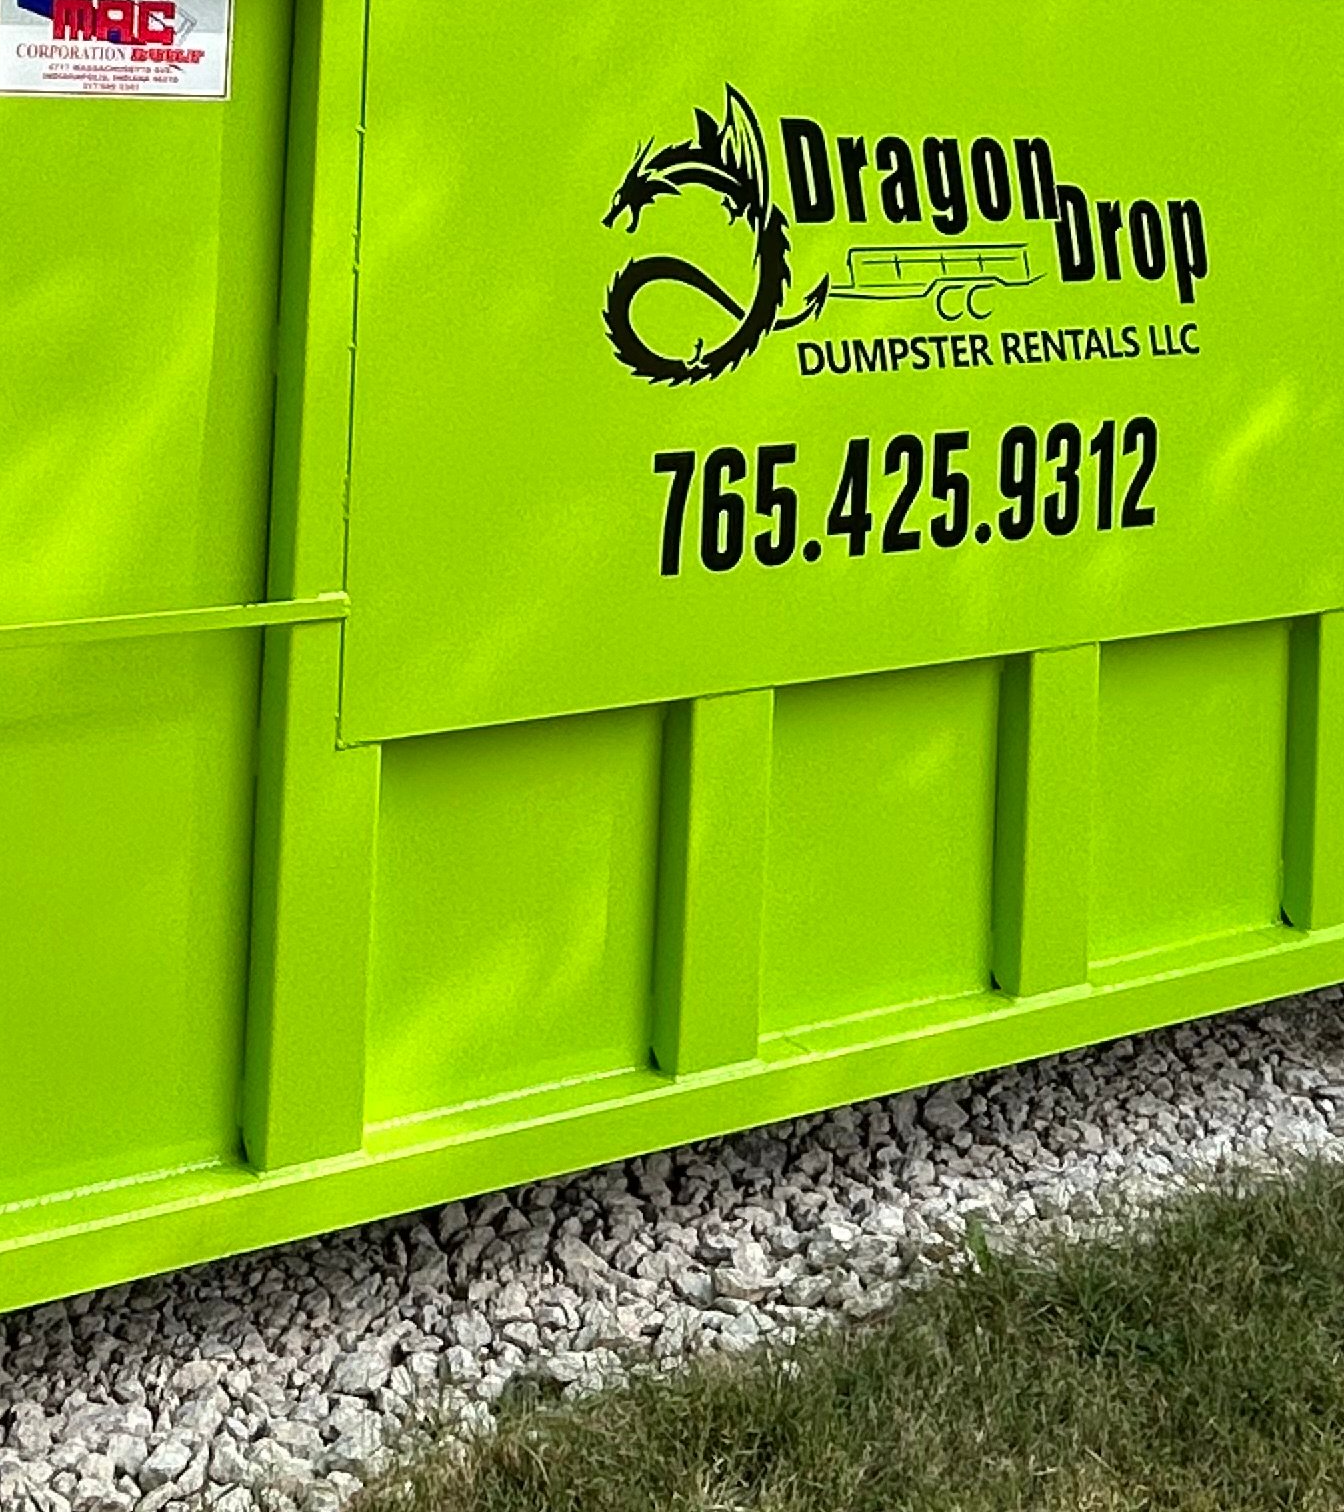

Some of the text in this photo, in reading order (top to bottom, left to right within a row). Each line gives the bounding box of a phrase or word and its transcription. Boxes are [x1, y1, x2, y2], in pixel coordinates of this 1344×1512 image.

[16, 43, 126, 61] CORPORATION
[780, 116, 1207, 303] Dragon Drop
[797, 323, 1200, 377] DUMPSTER RENTALS LLC
[654, 416, 1158, 575] 765.425.9312
